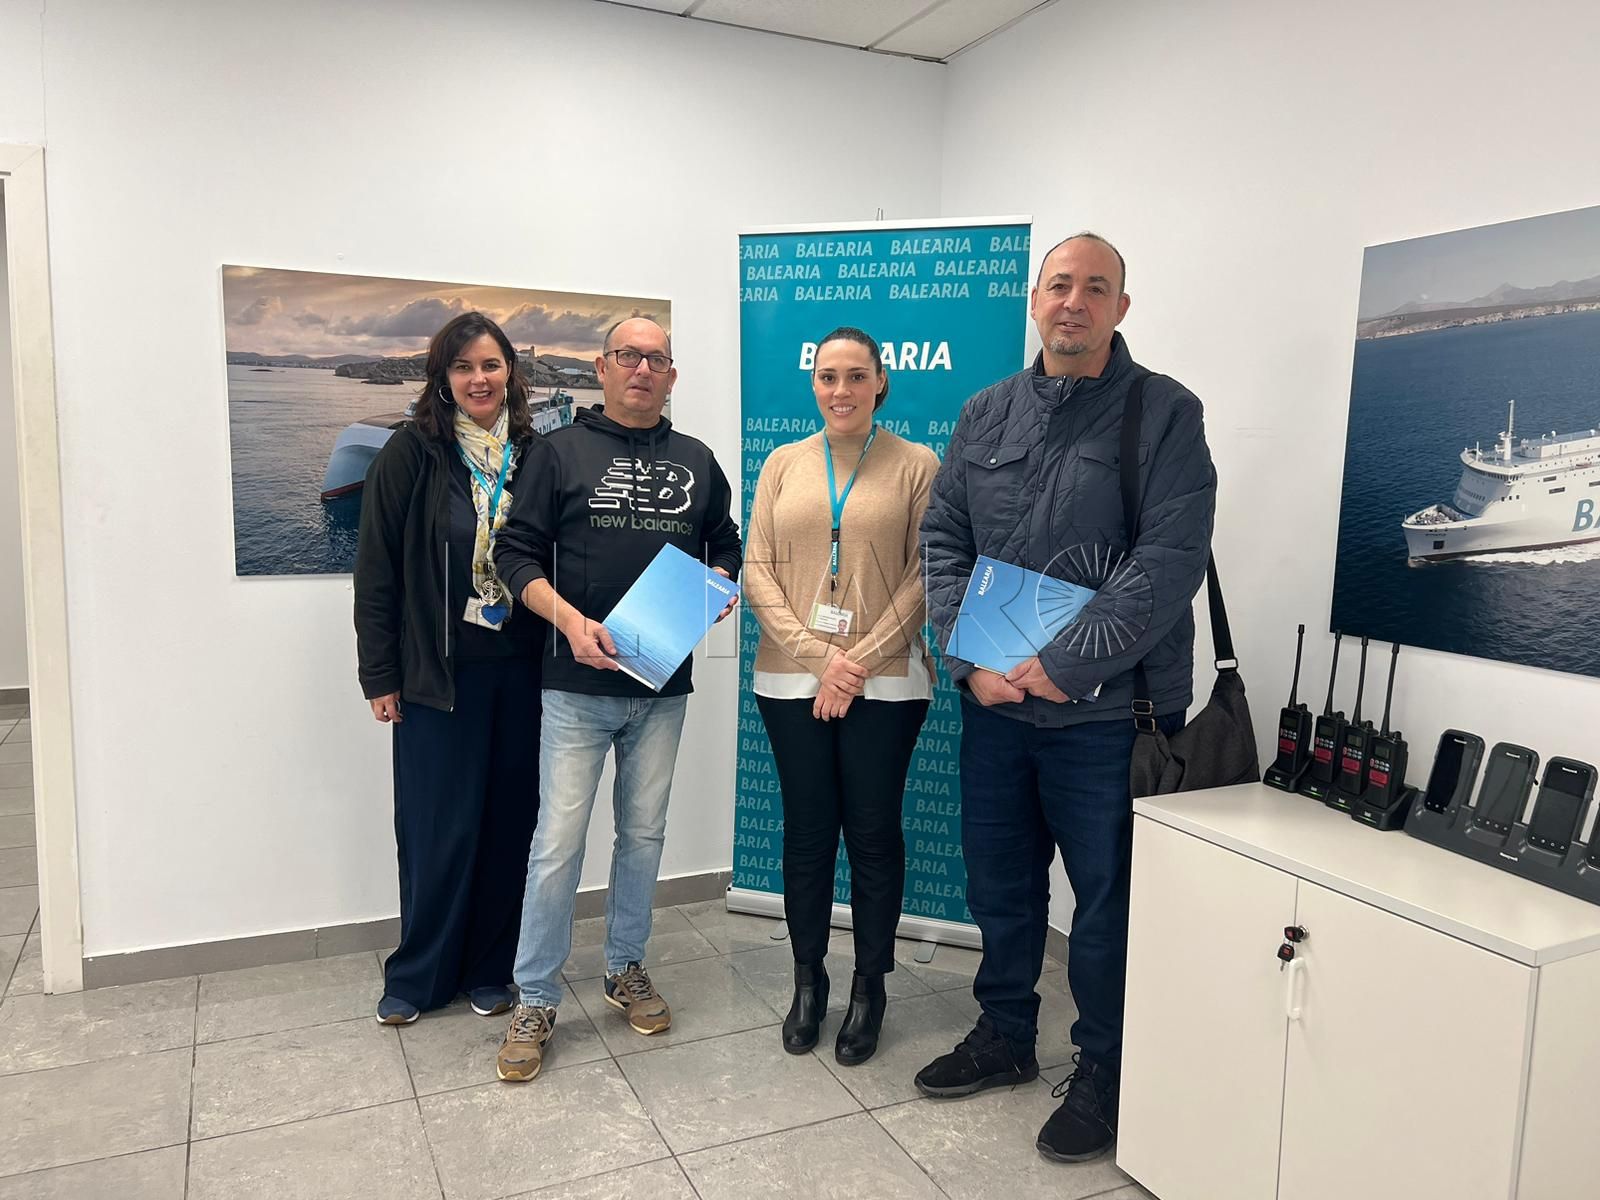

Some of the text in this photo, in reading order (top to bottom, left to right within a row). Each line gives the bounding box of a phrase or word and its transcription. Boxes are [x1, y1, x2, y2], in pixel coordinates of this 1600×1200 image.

[795, 240, 873, 258] BALEARIA
[890, 237, 972, 256] BALEARIA
[746, 258, 1018, 281] BALEARIA BALEARIA BALEARIA
[794, 285, 872, 301] BALEARIA
[889, 283, 970, 299] BALEARIA
[799, 341, 953, 371] BARIA
[746, 417, 817, 433] BALEARIA
[589, 514, 628, 529] new
[977, 565, 994, 596] BALEARIA
[913, 736, 952, 755] ARIA
[904, 778, 950, 796] EARIA
[902, 817, 949, 835] EARIA
[740, 816, 964, 859] BALEA BALEA
[739, 854, 965, 900] BALEA BALEA
[902, 897, 946, 917] EARIA
